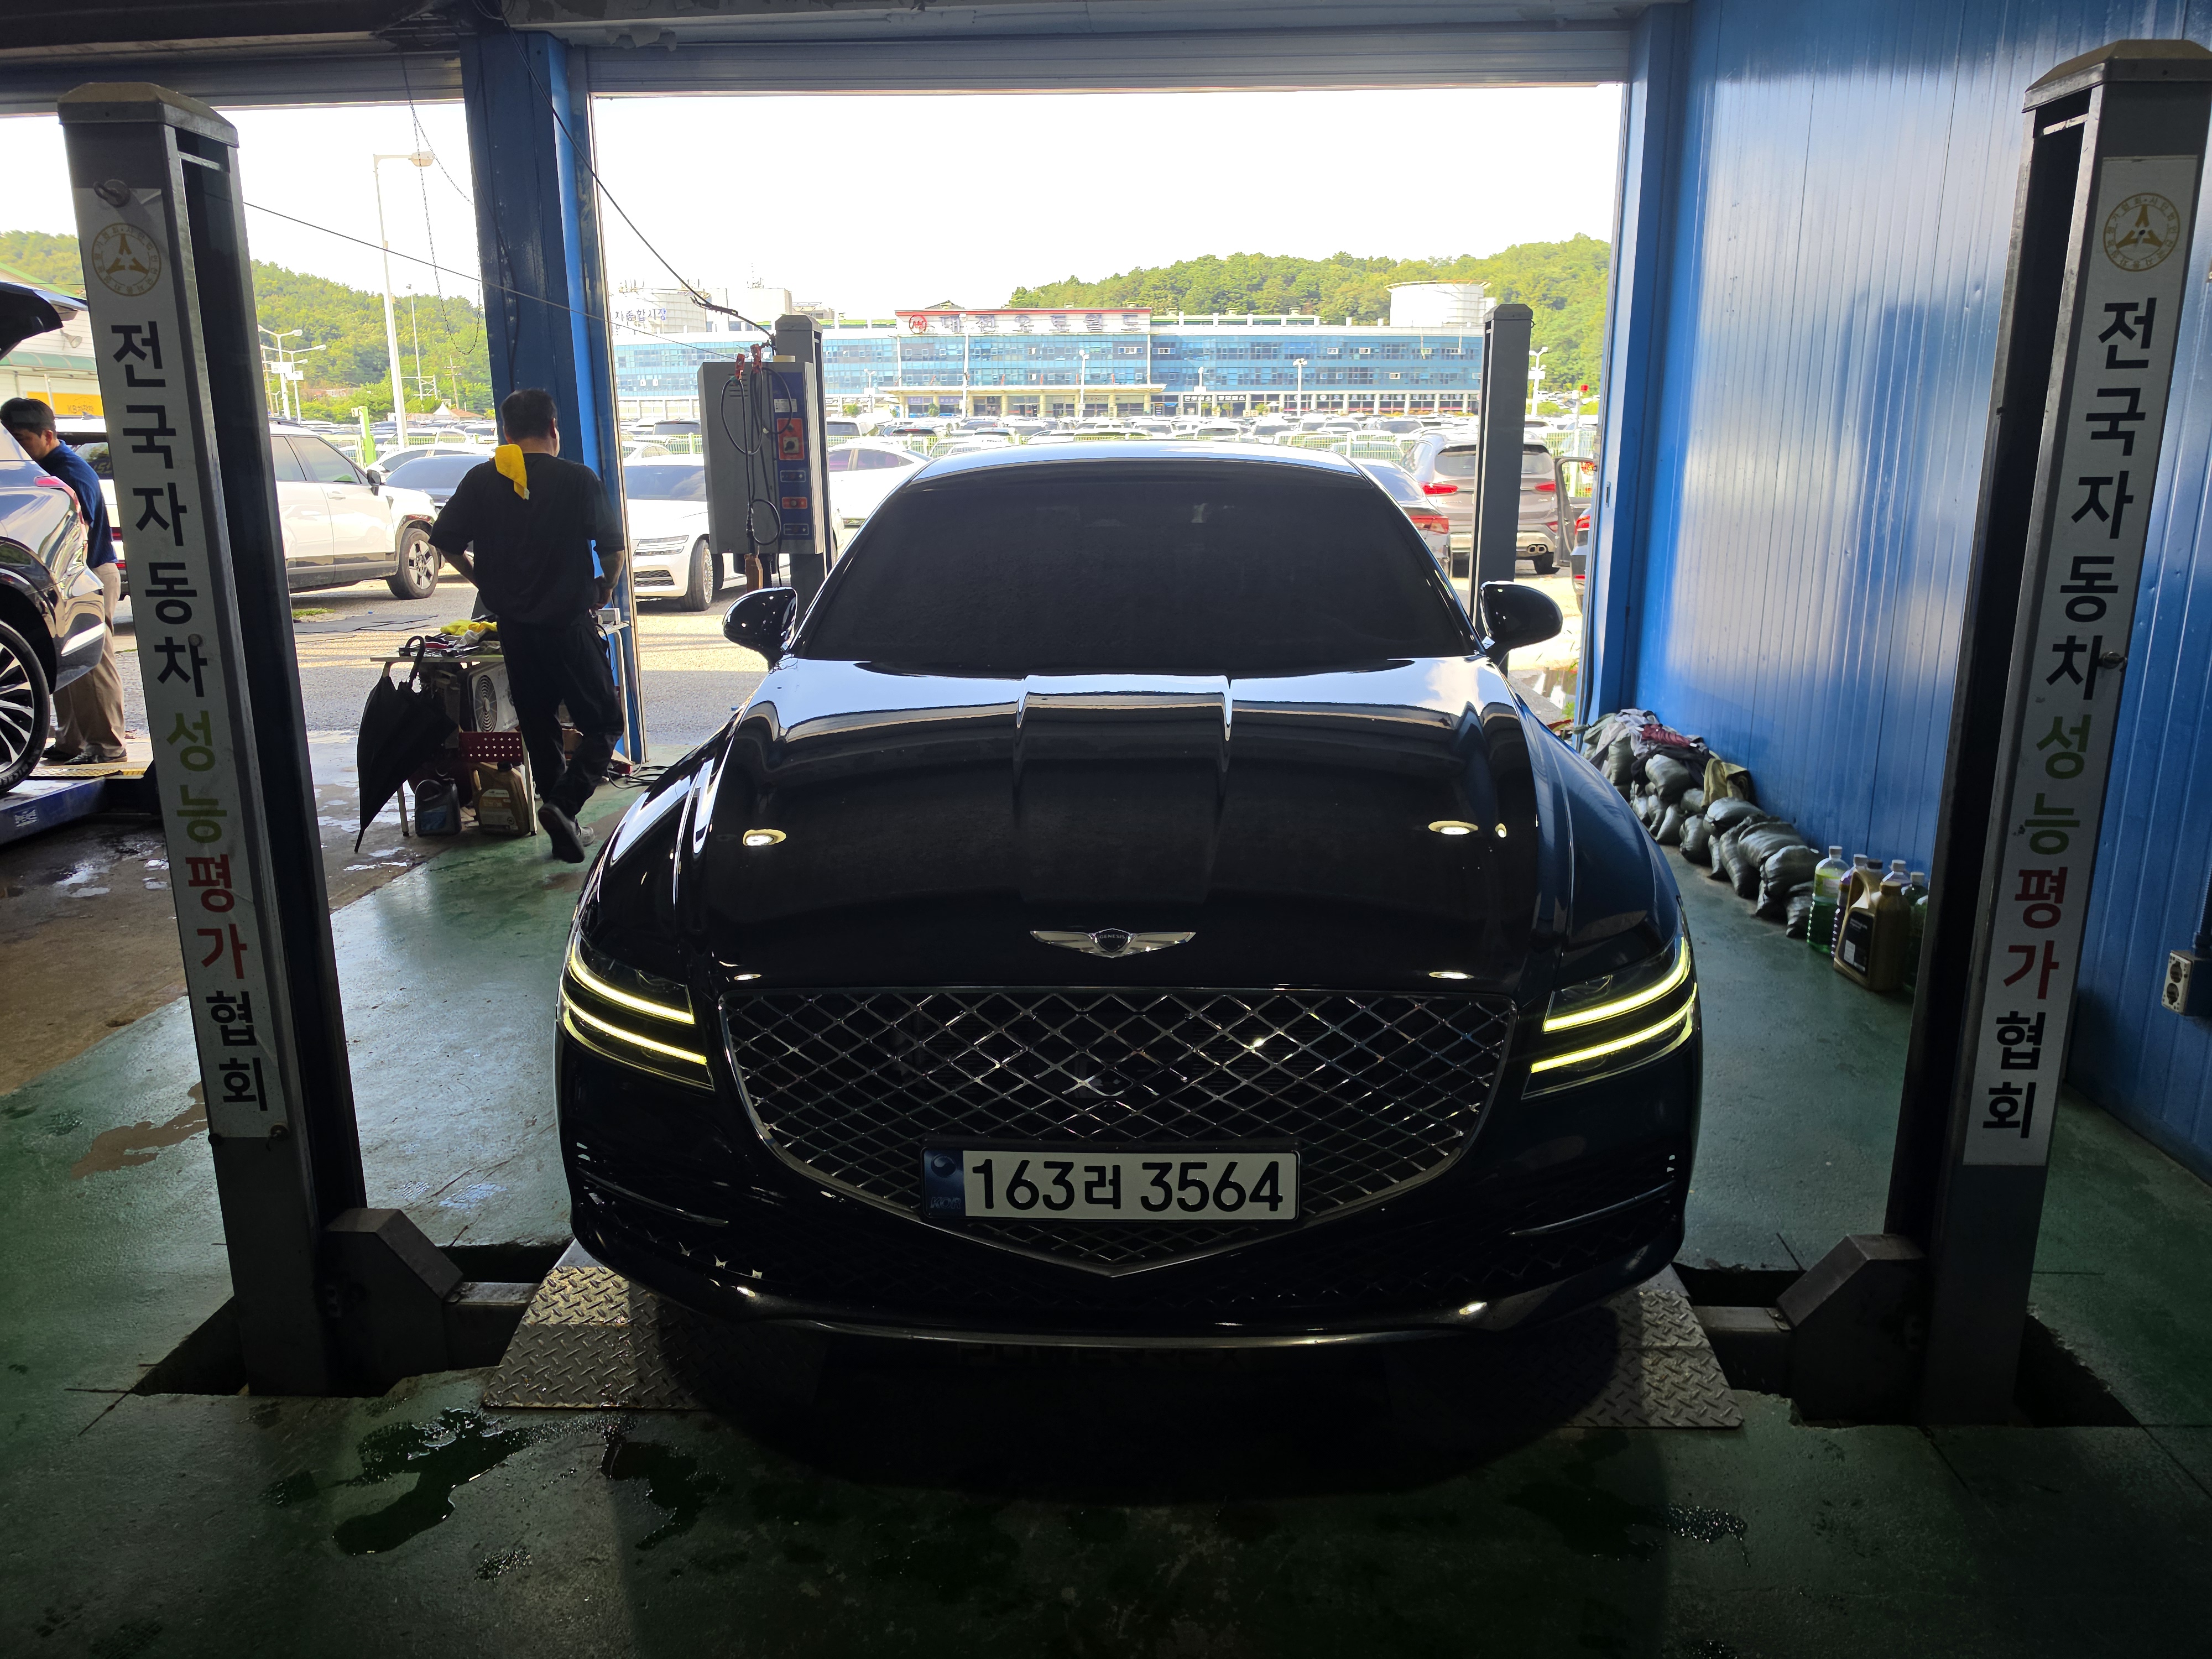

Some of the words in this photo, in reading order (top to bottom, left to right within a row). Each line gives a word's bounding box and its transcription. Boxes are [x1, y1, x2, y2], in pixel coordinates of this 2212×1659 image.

[972, 1159, 1121, 1211] 163러
[1140, 1161, 1284, 1212] 3564
[930, 1196, 962, 1209] KOR
